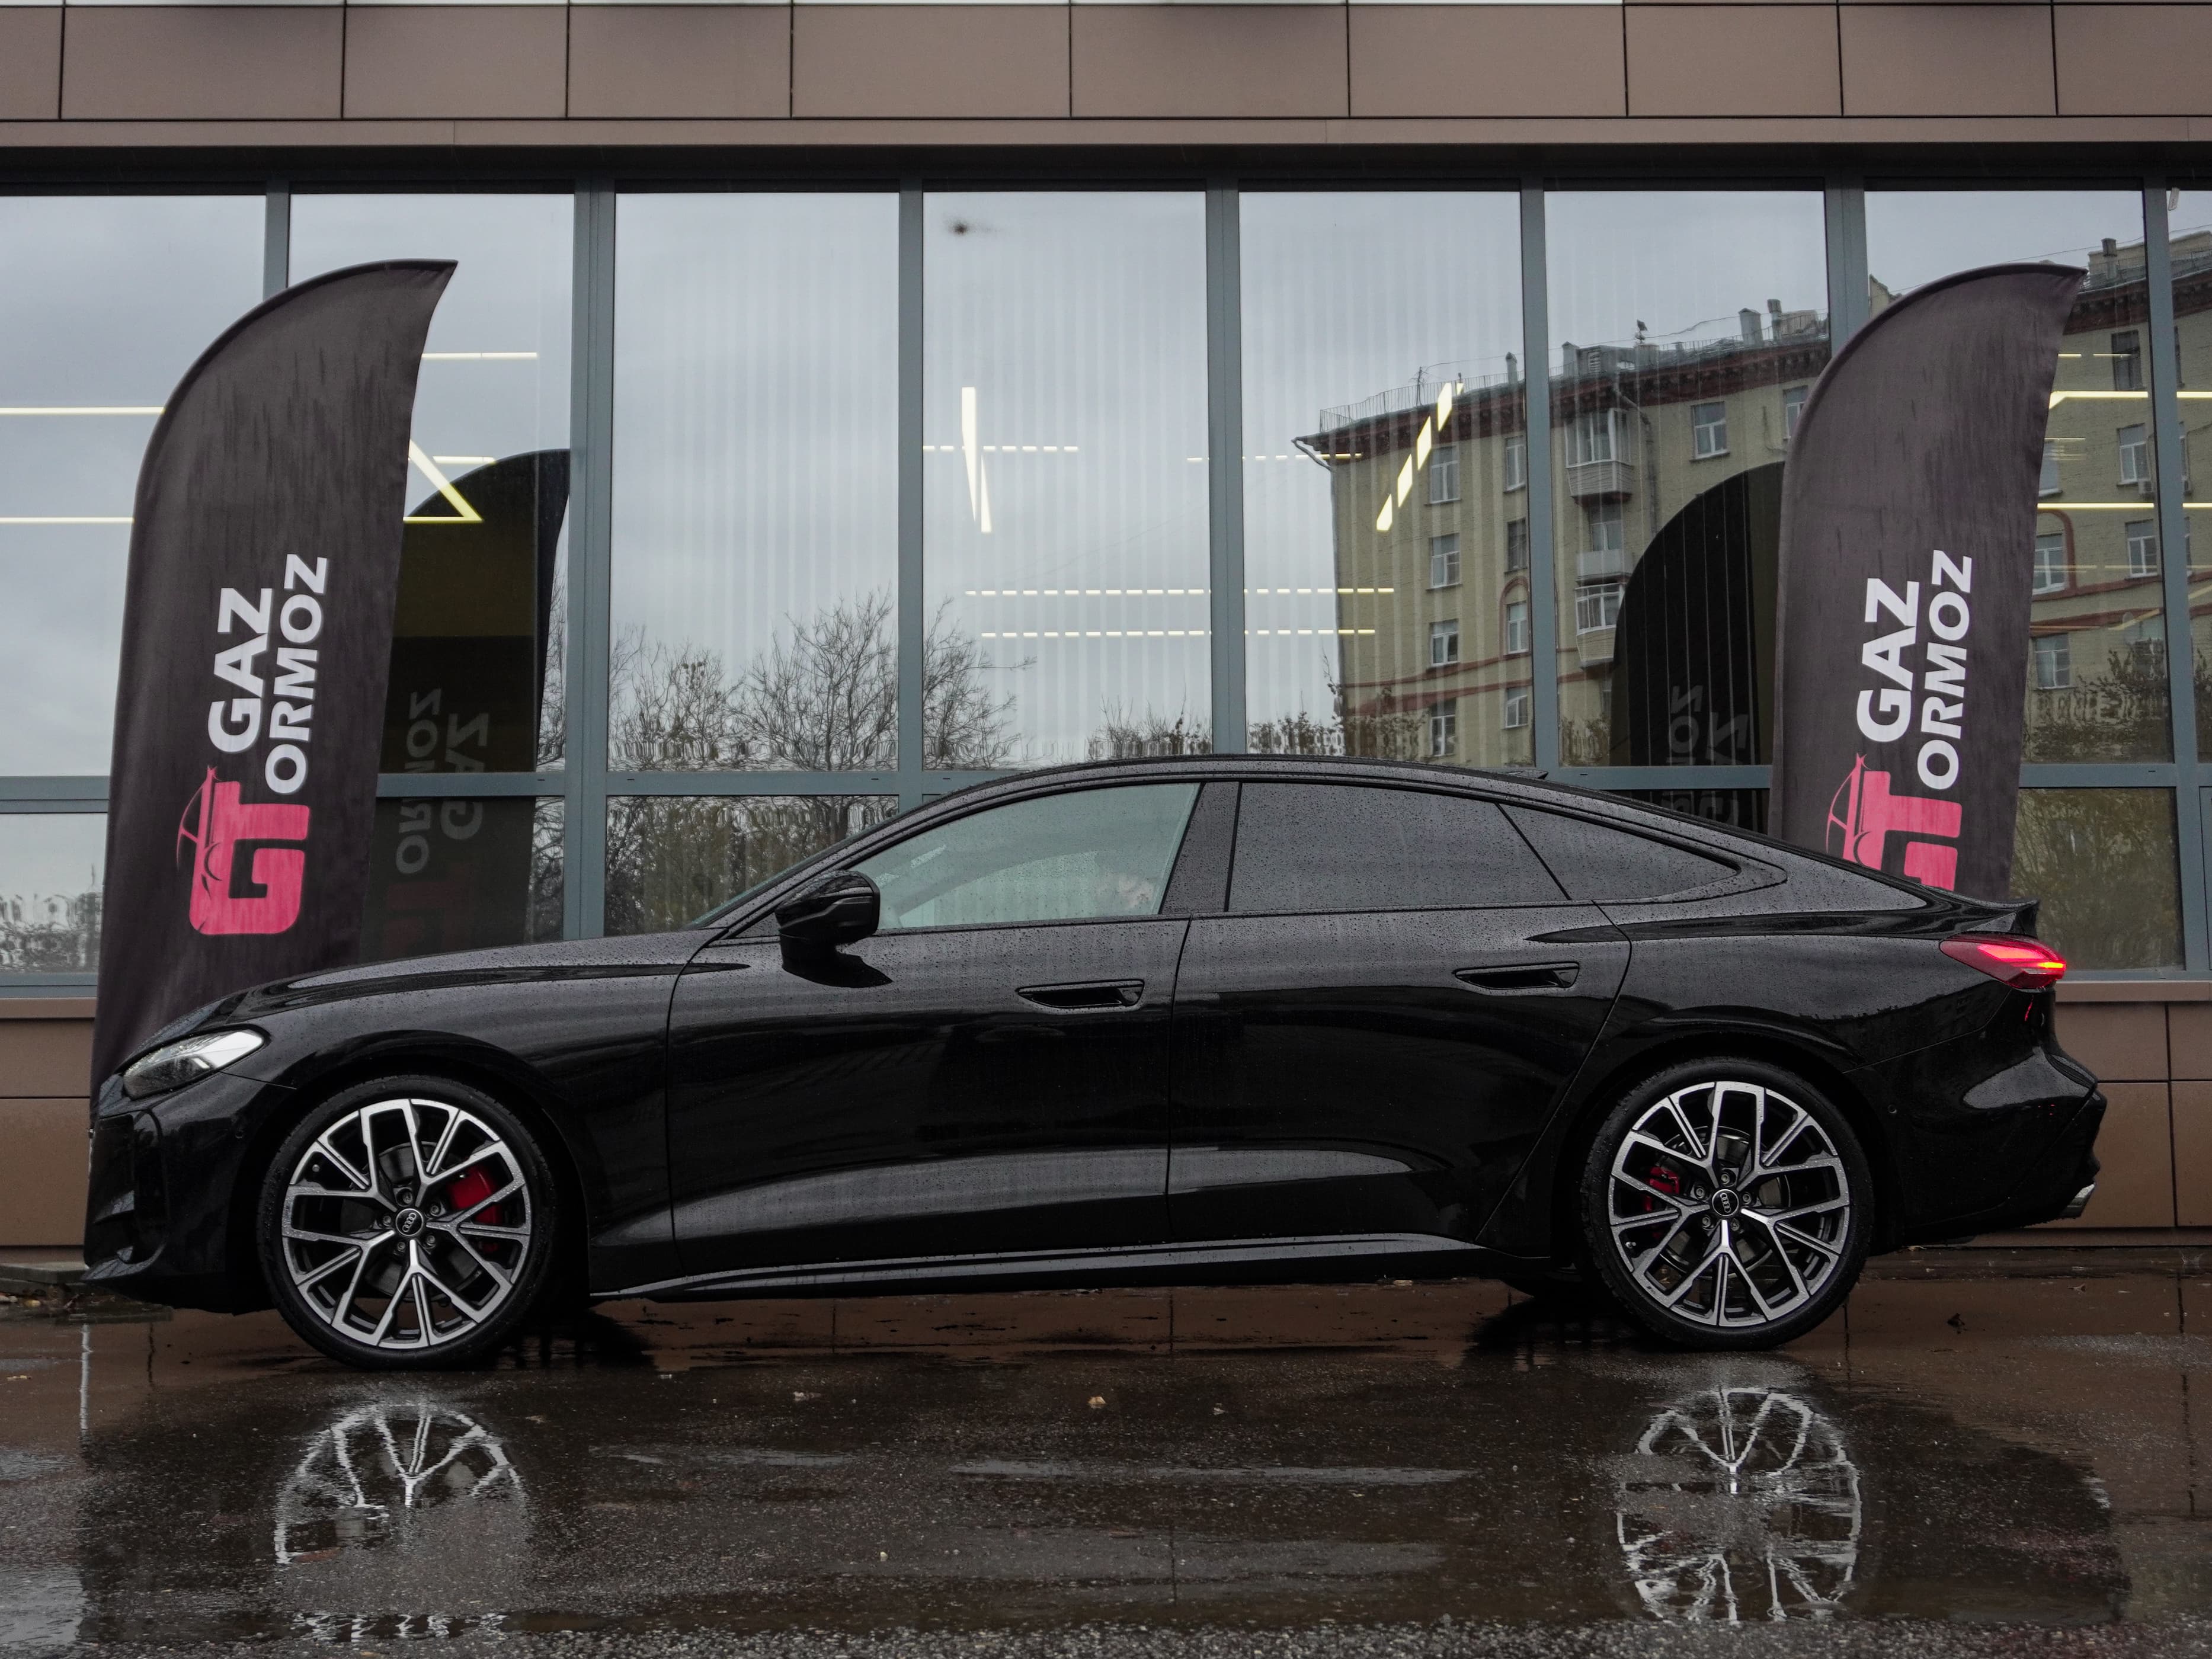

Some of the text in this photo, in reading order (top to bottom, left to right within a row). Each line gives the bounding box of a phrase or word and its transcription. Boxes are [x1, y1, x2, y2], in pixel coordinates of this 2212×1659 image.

[209, 588, 273, 752] GAZ
[265, 553, 328, 794] ORMOZ
[1856, 578, 1920, 742] GAZ
[1917, 549, 1973, 790] ORMOZ
